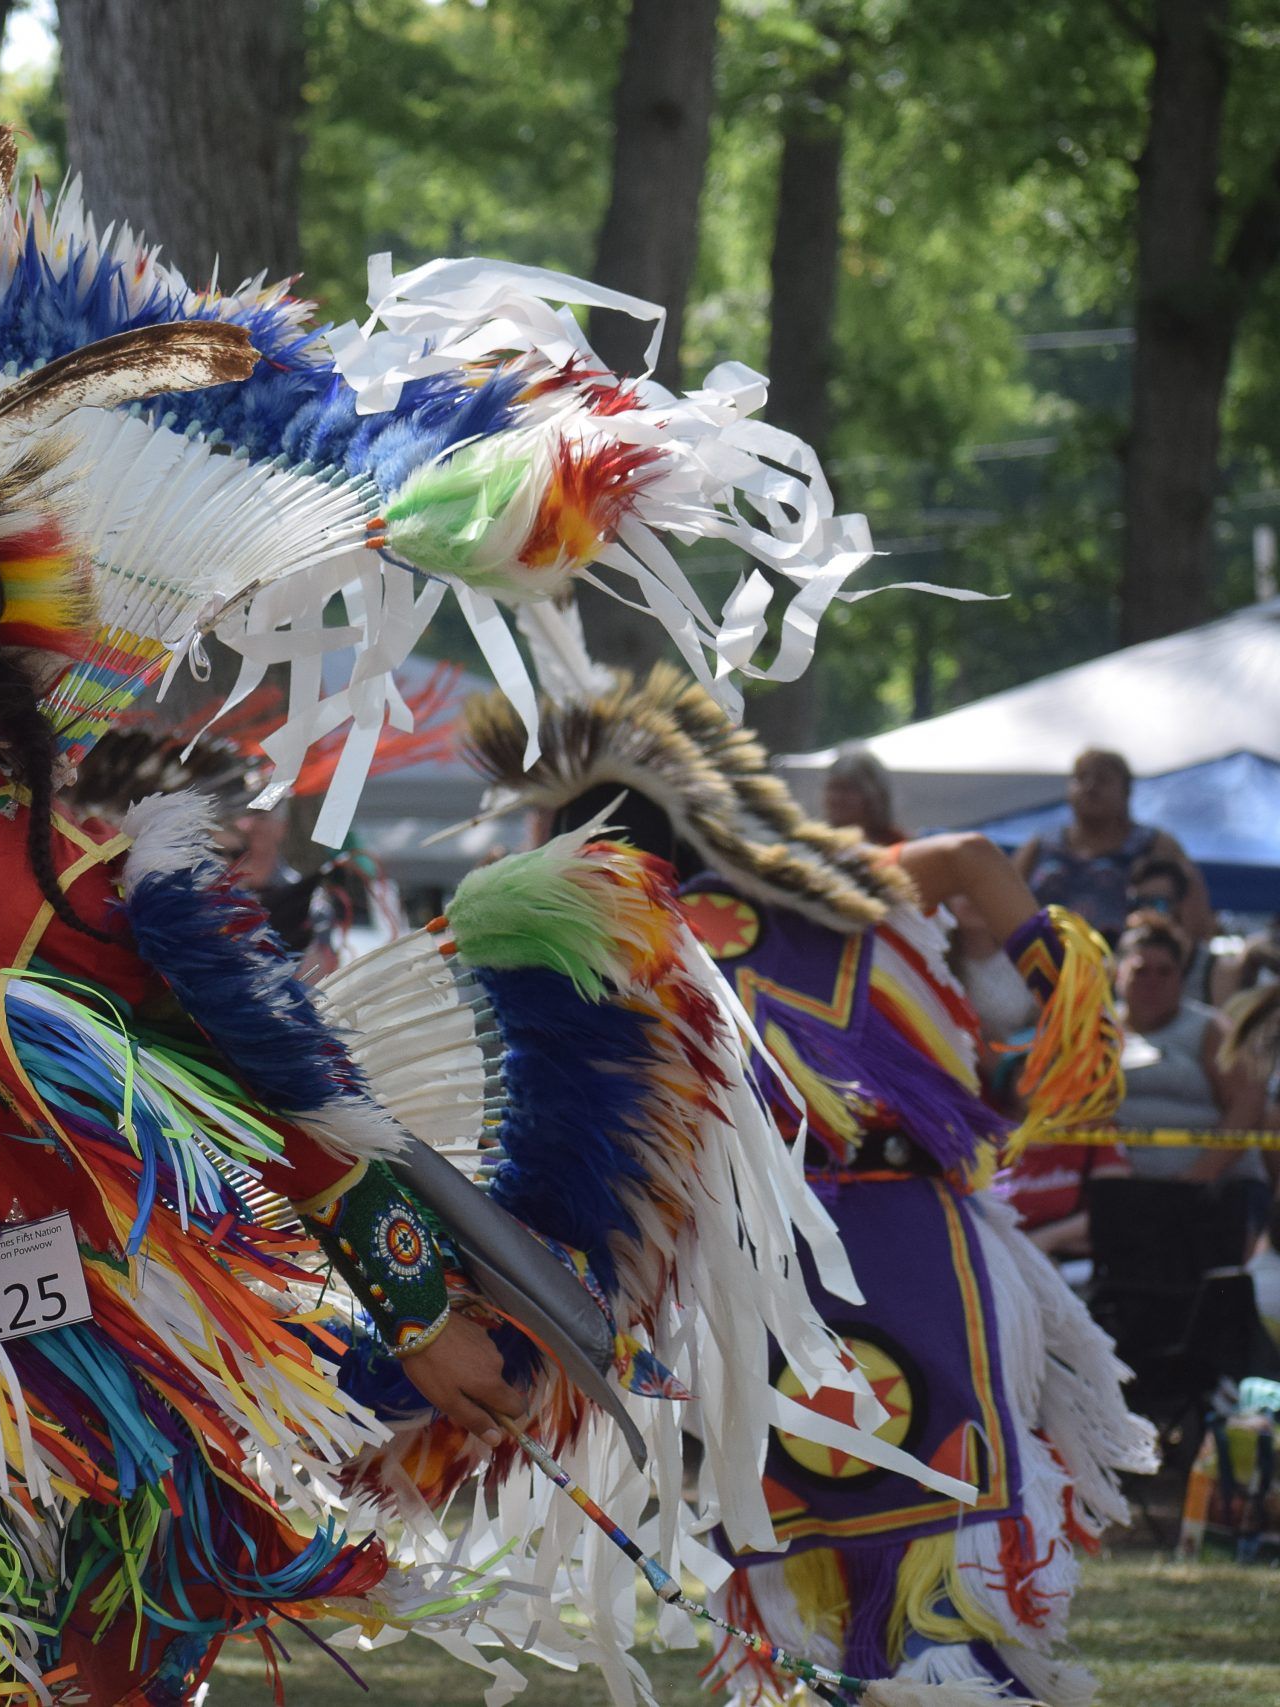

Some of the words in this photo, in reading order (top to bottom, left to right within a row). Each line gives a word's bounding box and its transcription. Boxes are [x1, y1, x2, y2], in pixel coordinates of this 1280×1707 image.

[16, 1233, 33, 1244] First
[35, 1225, 62, 1238] Nation
[14, 1240, 53, 1256] Powwow
